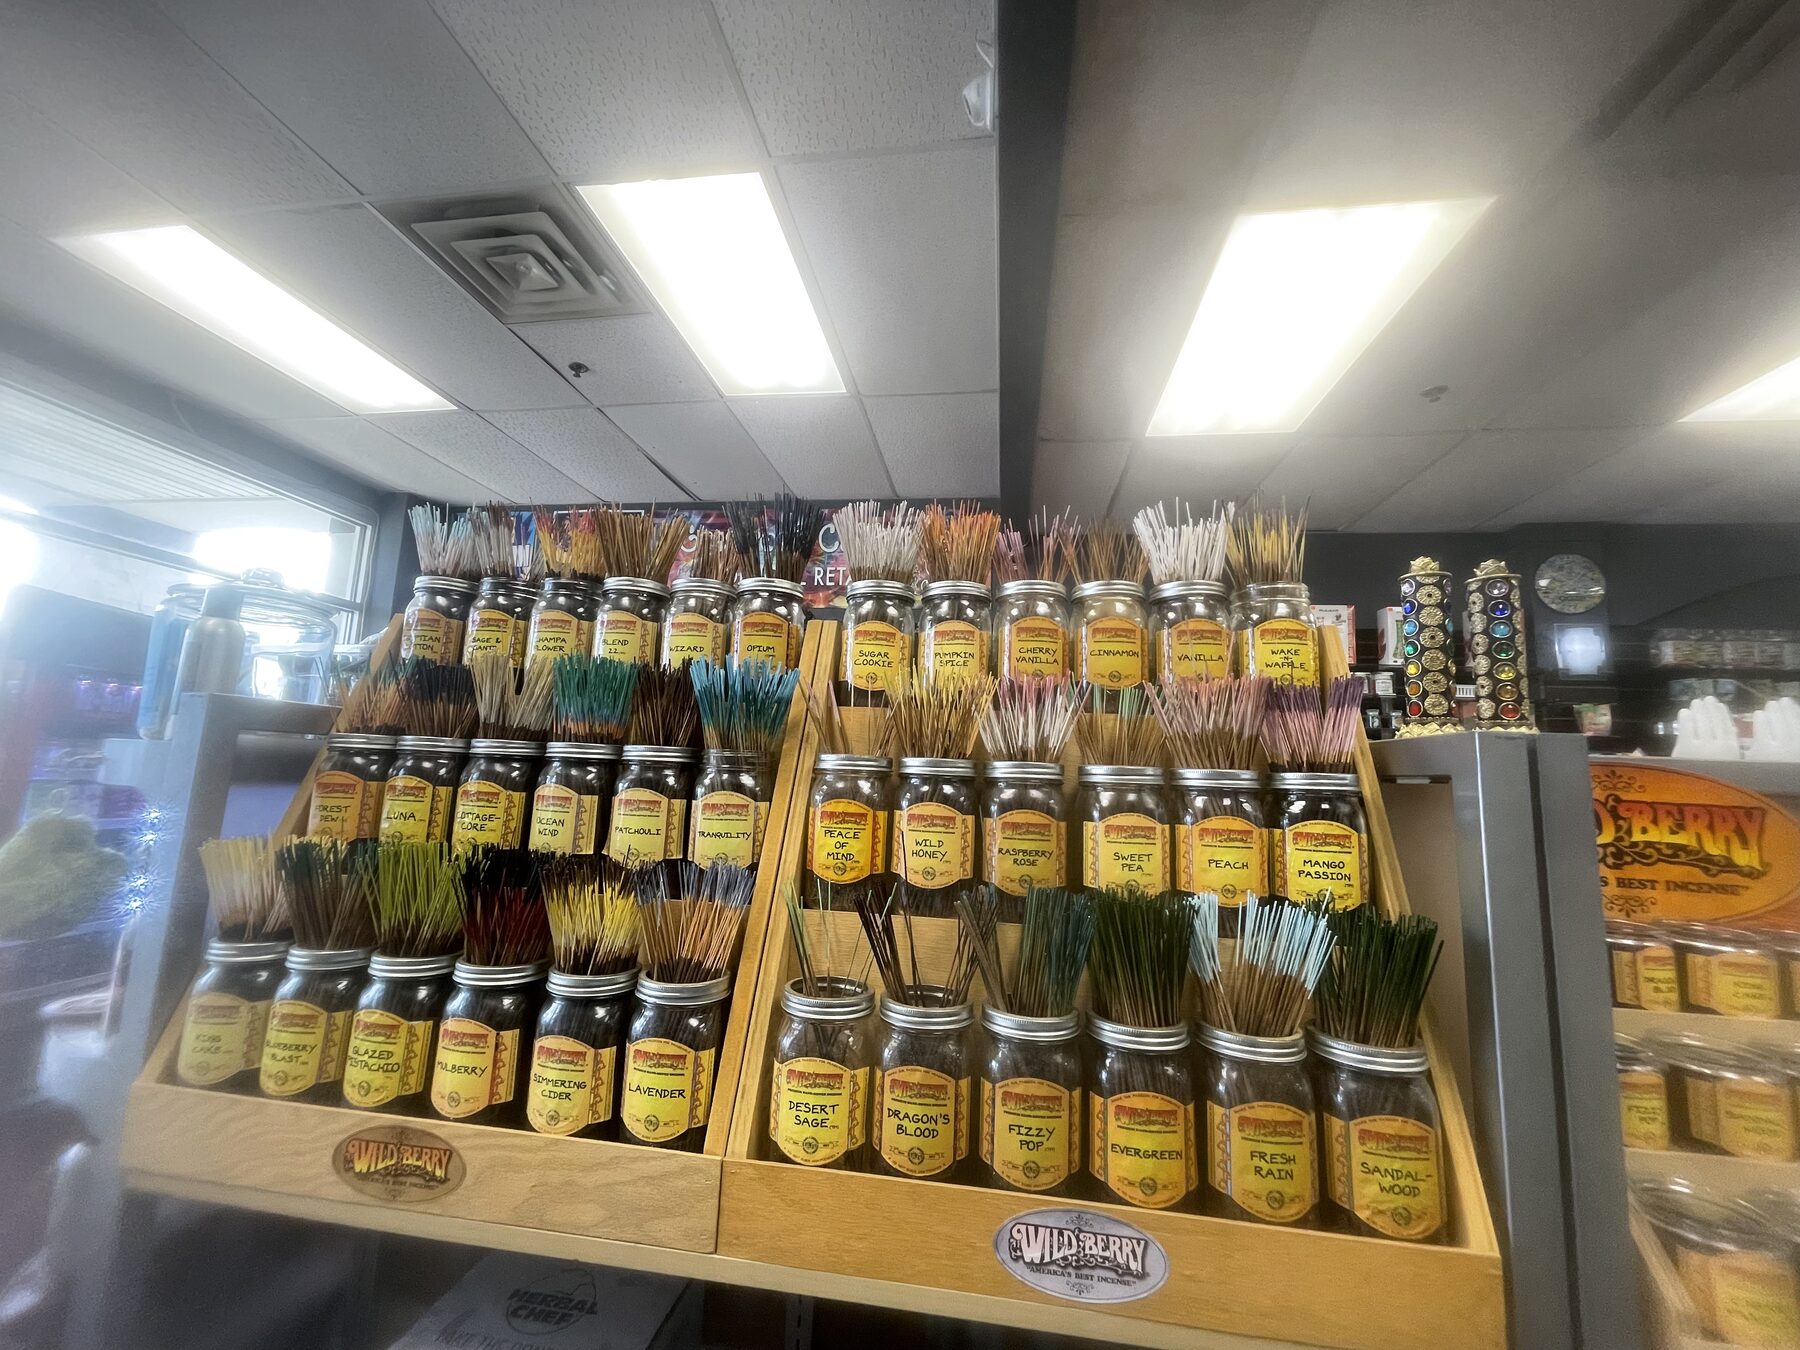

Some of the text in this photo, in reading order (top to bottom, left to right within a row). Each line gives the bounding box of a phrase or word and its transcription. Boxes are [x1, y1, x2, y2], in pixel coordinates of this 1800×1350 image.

[670, 645, 705, 653] WIZARD
[746, 644, 775, 653] OPIUM
[858, 649, 890, 659] SUGAR
[1018, 646, 1058, 657] CHERRY
[1090, 649, 1140, 658] CINNAMON
[1270, 648, 1301, 656] WAKE
[934, 651, 975, 659] PUMPKIN
[1016, 655, 1059, 665] VANILLA
[1177, 653, 1224, 662] VANILLA
[854, 658, 894, 668] COOKIE
[939, 659, 970, 667] SPICE
[1265, 661, 1306, 670] WAFFLE
[386, 811, 417, 822] LUNA
[536, 816, 565, 828] OCEAN
[461, 821, 488, 832] CORE
[538, 828, 559, 837] WIND
[615, 826, 662, 836] PATCHOULI
[698, 830, 752, 841] TRANQUILITY
[824, 829, 861, 840] PEACE
[1616, 801, 1767, 871] BERRY
[834, 841, 849, 849] OF
[914, 838, 944, 849] WILD
[826, 852, 855, 862] MIND
[911, 849, 948, 862] HONEY
[997, 847, 1054, 860] RASPBERRY
[1113, 852, 1153, 862] SWEET
[1012, 858, 1039, 867] ROSE
[1121, 863, 1144, 873] PEA
[1208, 858, 1249, 870] PEACH
[1303, 859, 1346, 869] MANGO
[1297, 869, 1351, 882] PASSION
[1616, 876, 1659, 891] BEST
[352, 1045, 394, 1060] GLAZED
[437, 1060, 488, 1078] MULBERRY
[533, 1073, 587, 1090] SIMMERING
[541, 1089, 572, 1101] CIDER
[628, 1082, 686, 1099] LAVENDER
[788, 1100, 840, 1116] DESERT
[794, 1114, 830, 1128] SAGE
[887, 1107, 950, 1126] DRAGON'S
[896, 1123, 939, 1139] BLOOD
[1008, 1123, 1056, 1141] FIZZY
[1019, 1139, 1044, 1152] POP
[1110, 1143, 1183, 1161] EVERGREEN
[1250, 1150, 1296, 1165] FRESH
[347, 1139, 452, 1179] WILD BERRY
[1253, 1165, 1294, 1181] RAIN
[1360, 1161, 1433, 1182] SANDAL-
[1378, 1181, 1421, 1198] WOOD
[1010, 1223, 1147, 1273] WILD BERRY
[1074, 1272, 1094, 1281] BEST
[508, 1289, 599, 1315] HERBAL
[510, 1305, 575, 1325] CHEF
